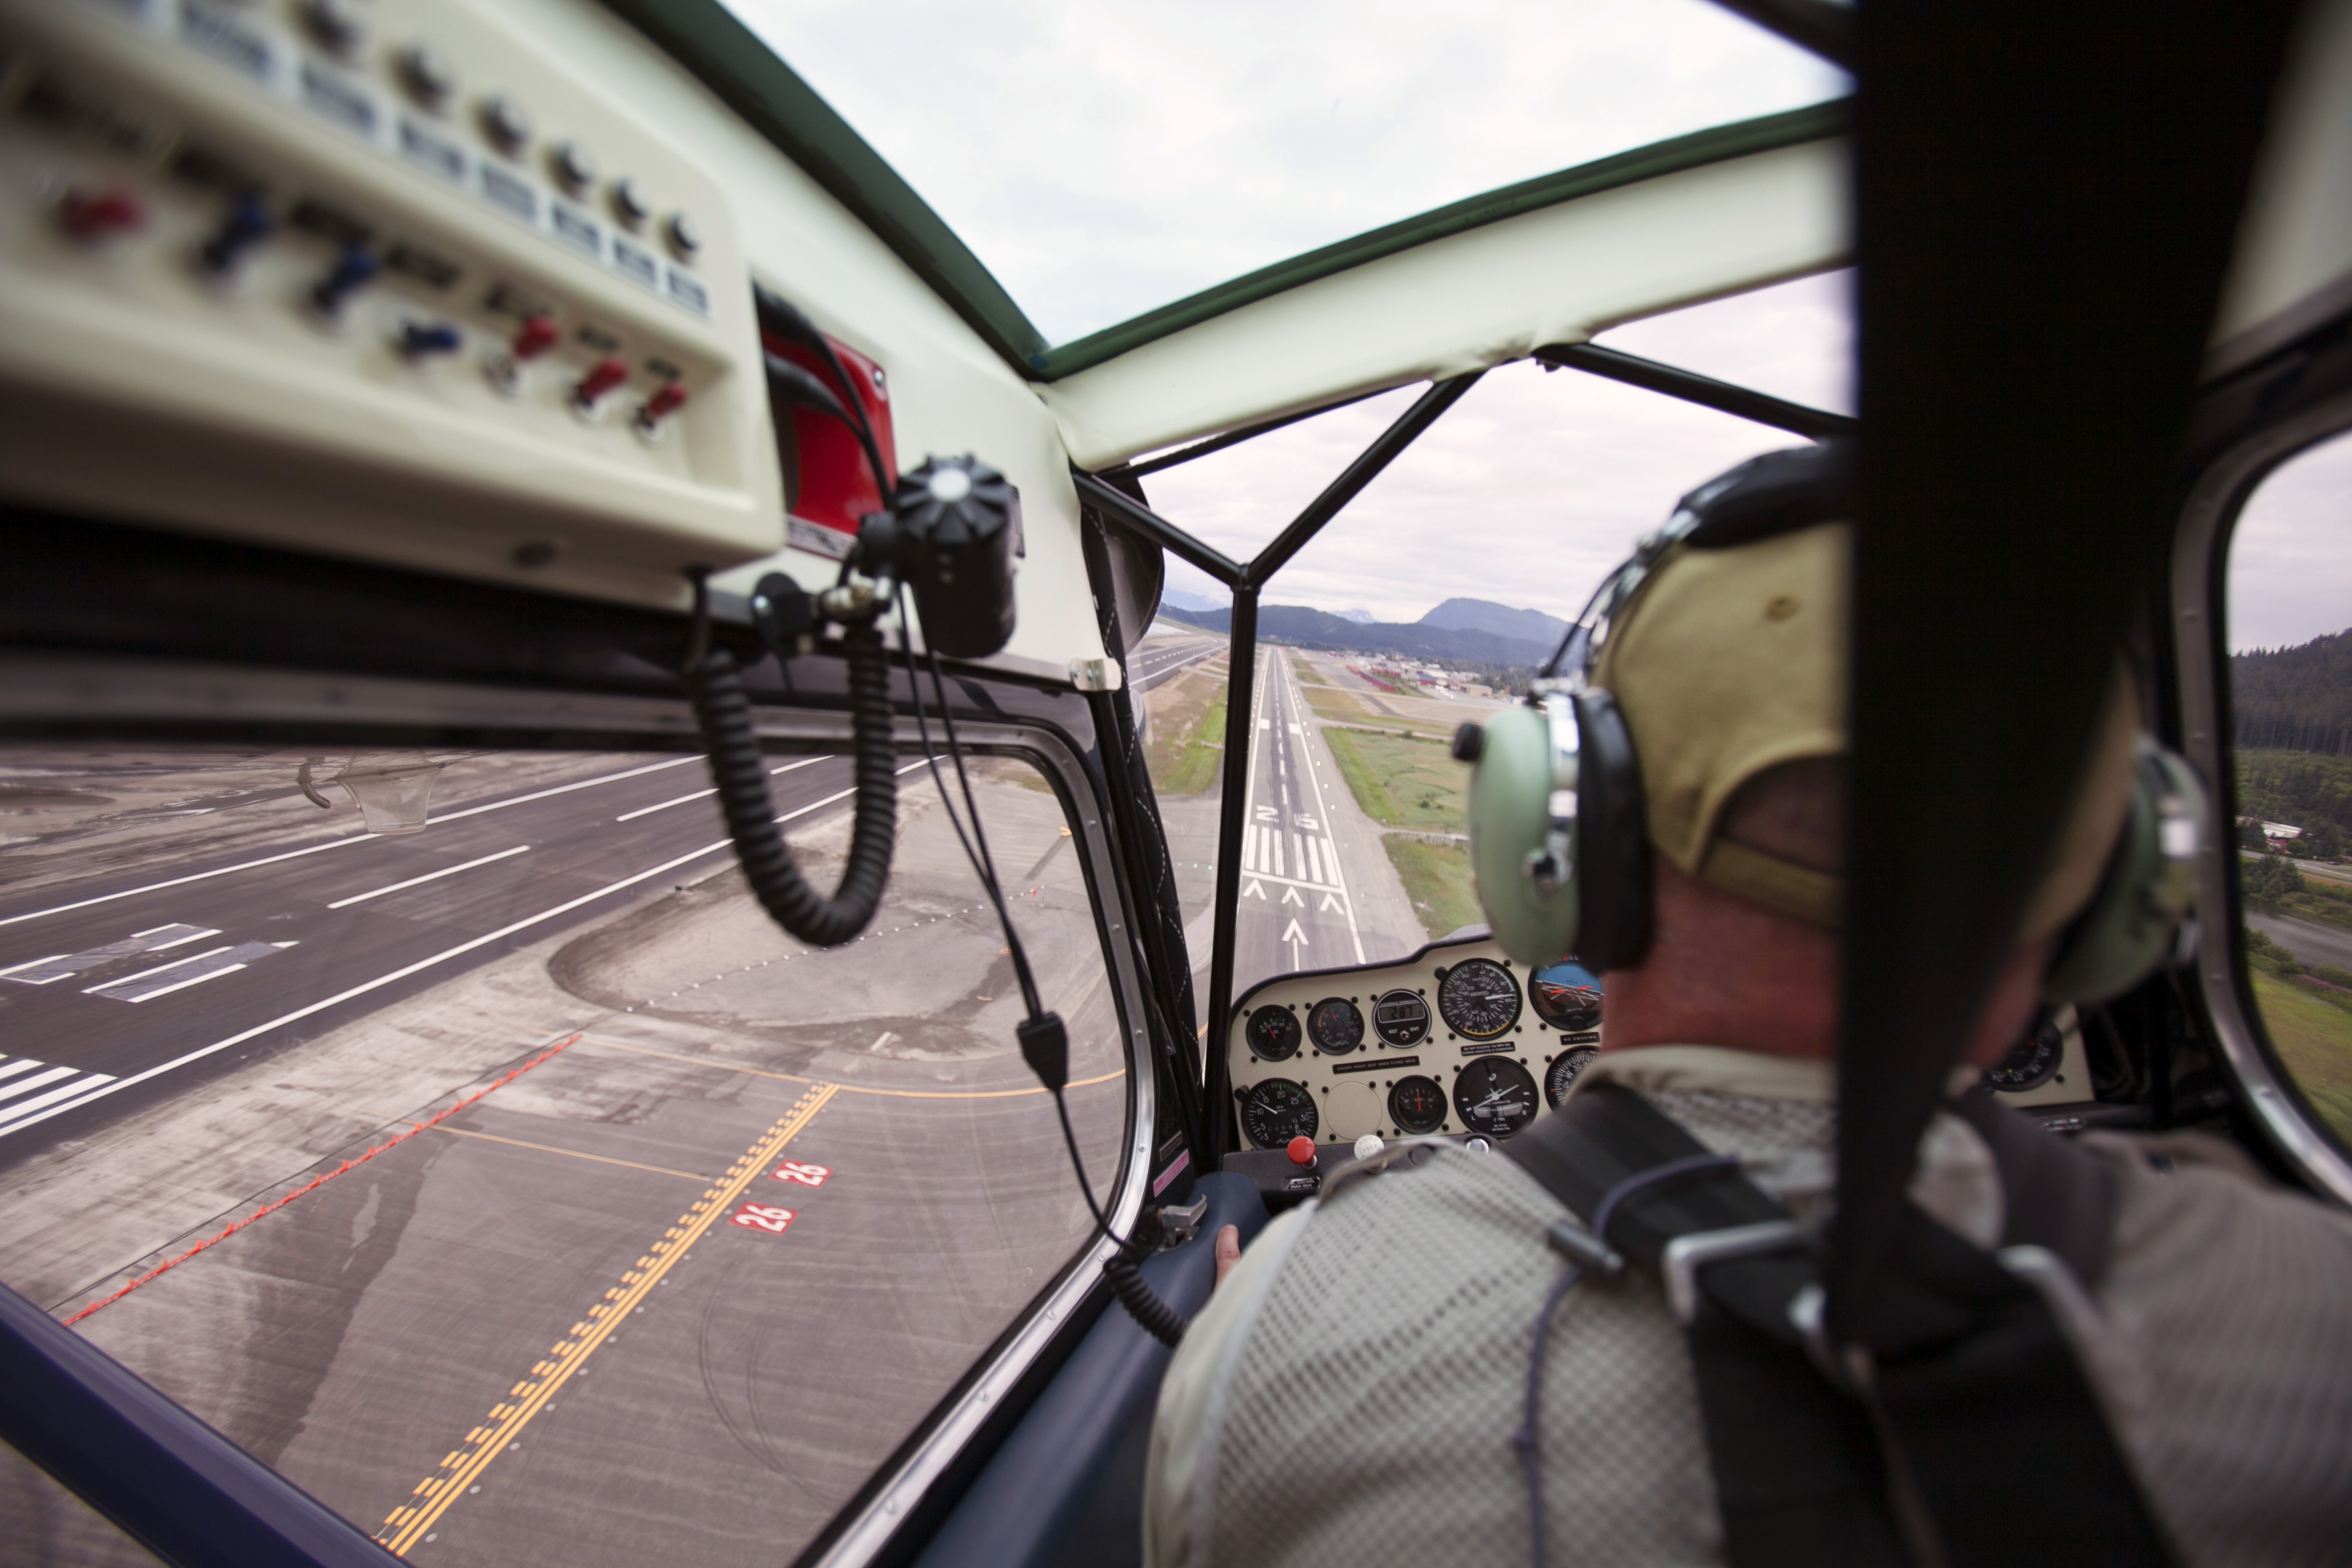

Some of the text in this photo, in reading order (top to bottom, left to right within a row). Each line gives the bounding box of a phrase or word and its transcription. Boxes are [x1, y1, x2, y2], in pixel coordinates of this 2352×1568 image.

[1391, 1006, 1413, 1019] 287
[1565, 1070, 1573, 1079] W
[1357, 1136, 1379, 1150] ENGINE
[1359, 1143, 1379, 1154] ESSEX
[775, 1162, 830, 1187] 26
[735, 1204, 793, 1233] 26
